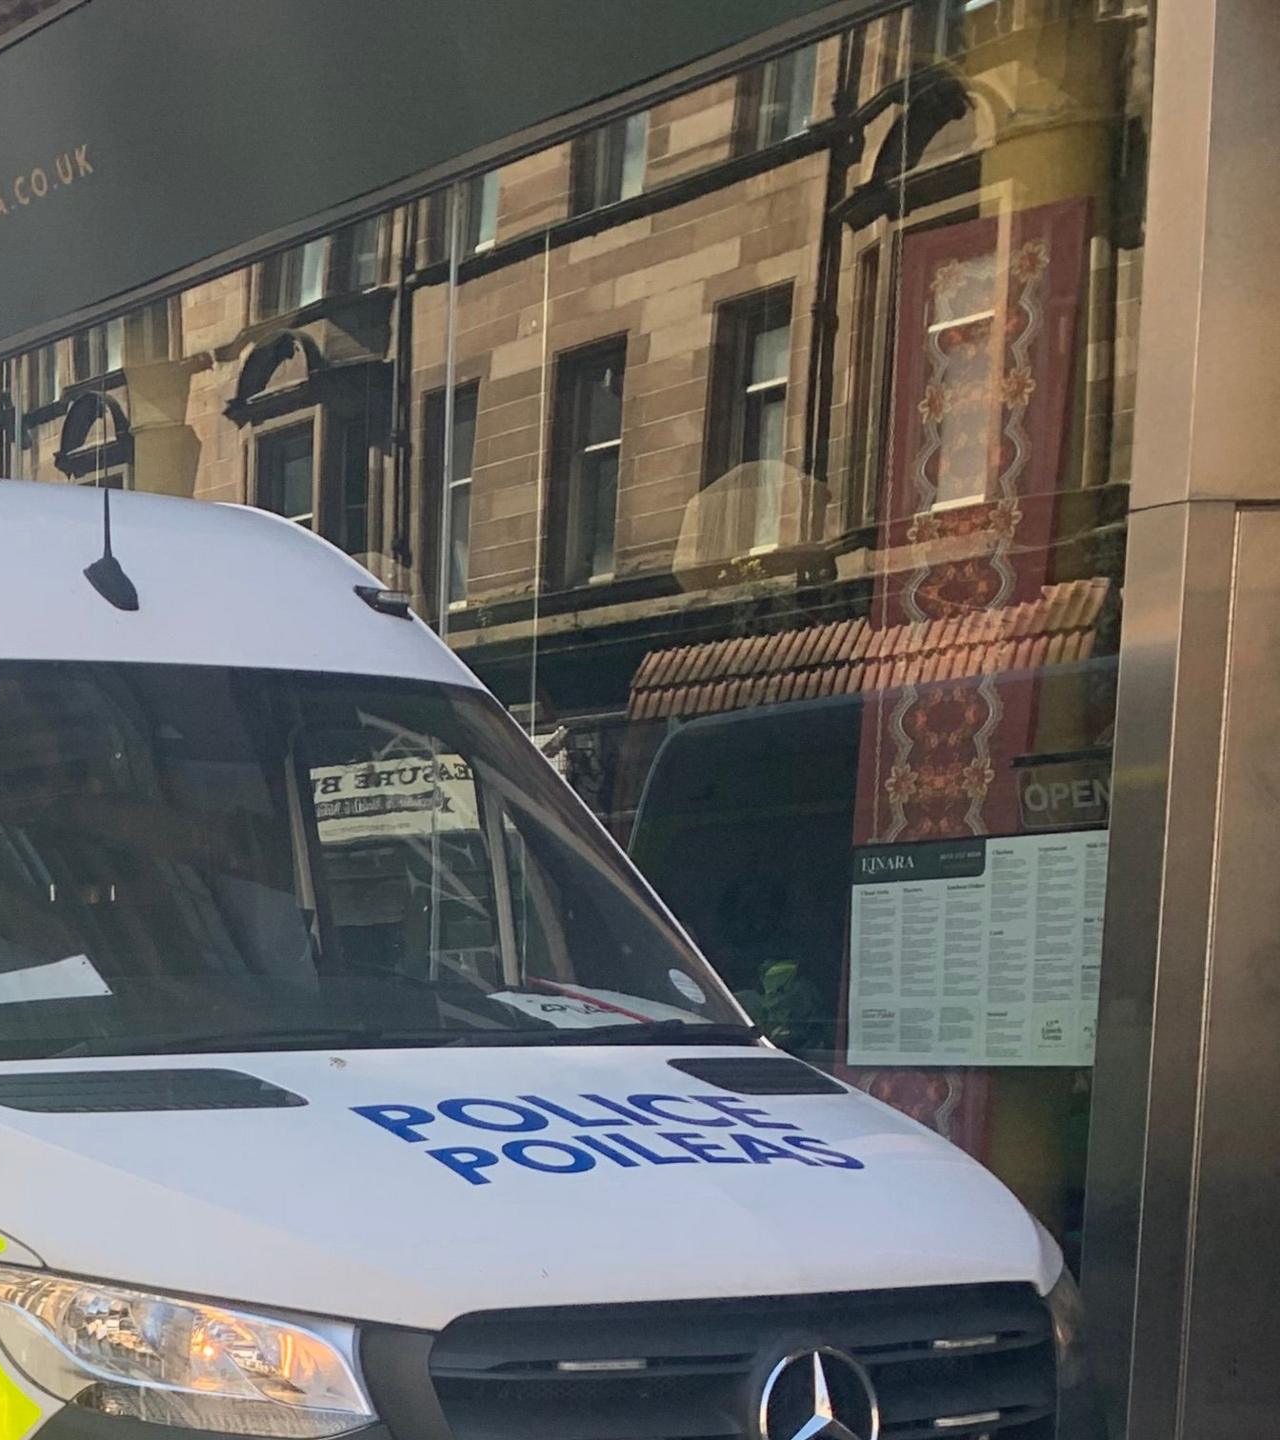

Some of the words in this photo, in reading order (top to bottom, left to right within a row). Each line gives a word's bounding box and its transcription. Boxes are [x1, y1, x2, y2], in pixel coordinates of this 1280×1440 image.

[1025, 779, 1111, 811] OPEN
[862, 855, 915, 874] KINARA
[350, 1093, 801, 1143] POLICE
[426, 1132, 865, 1185] POILEAS
